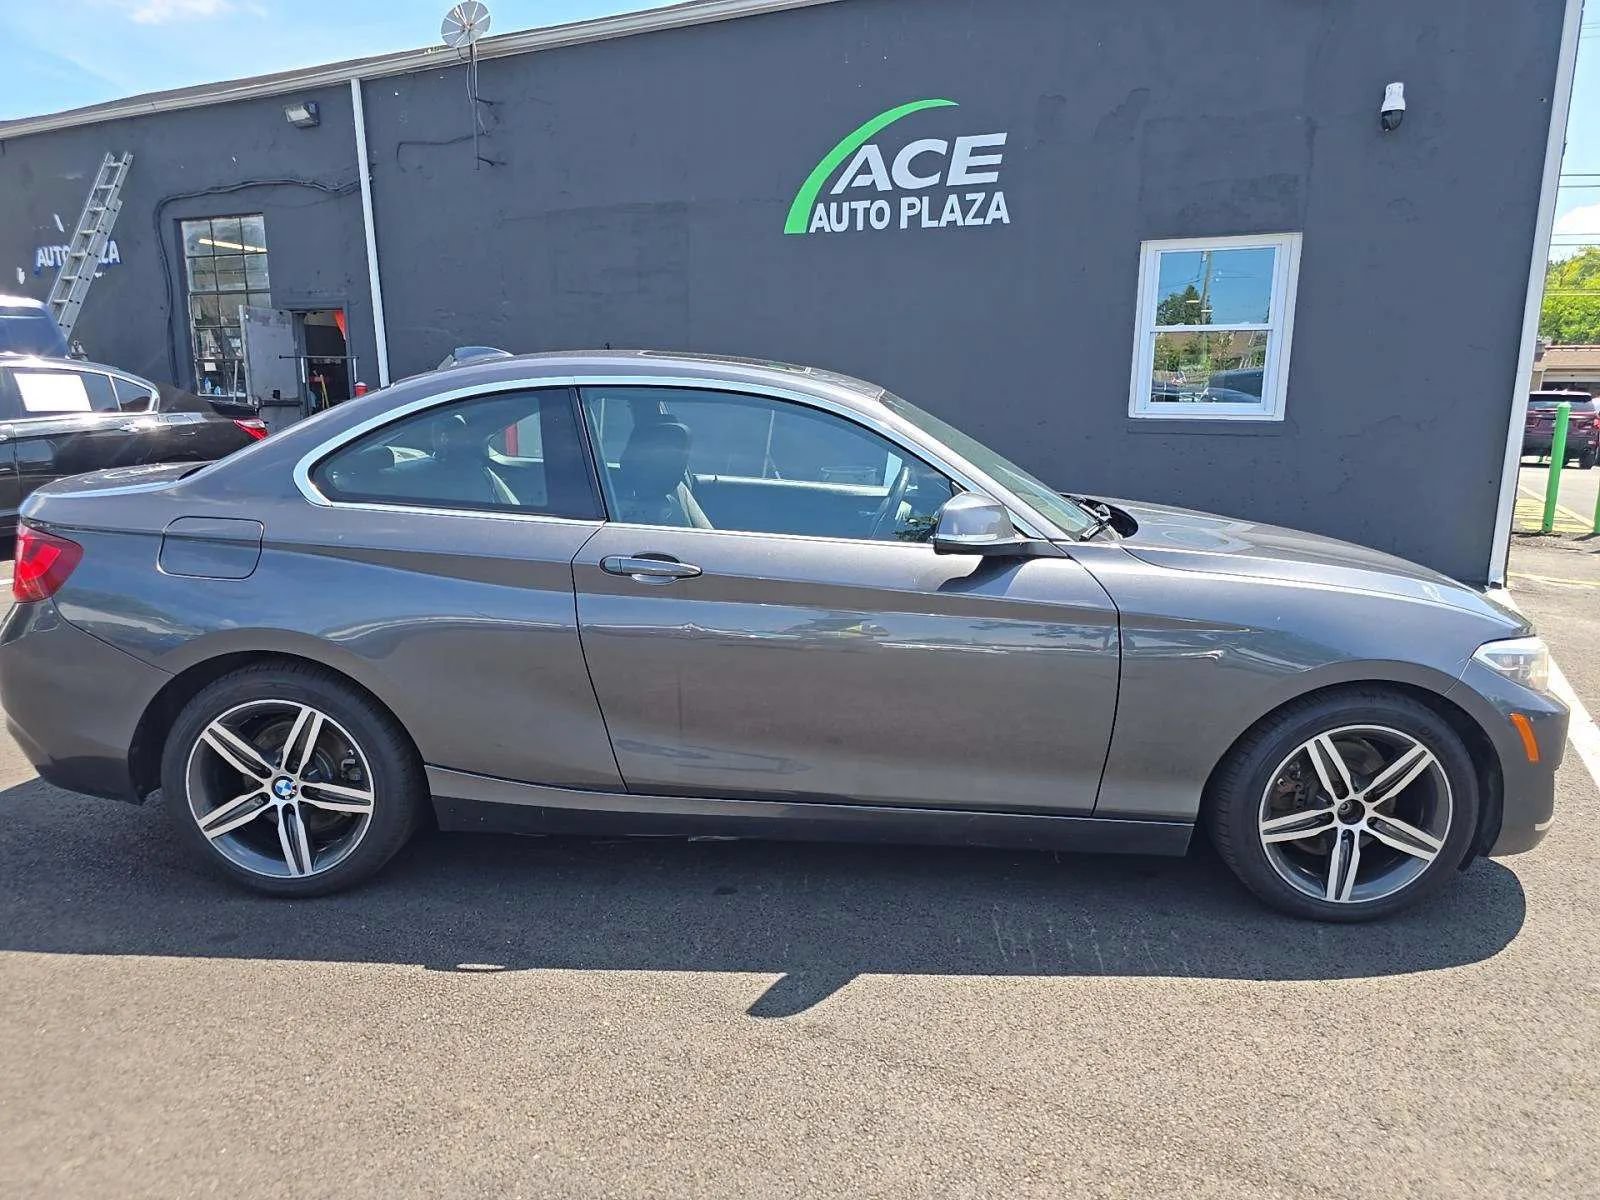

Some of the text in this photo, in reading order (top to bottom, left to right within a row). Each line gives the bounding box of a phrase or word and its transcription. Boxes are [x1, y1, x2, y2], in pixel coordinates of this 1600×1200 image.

[830, 132, 1007, 195] ACE
[809, 191, 1010, 233] AUTO PLAZA
